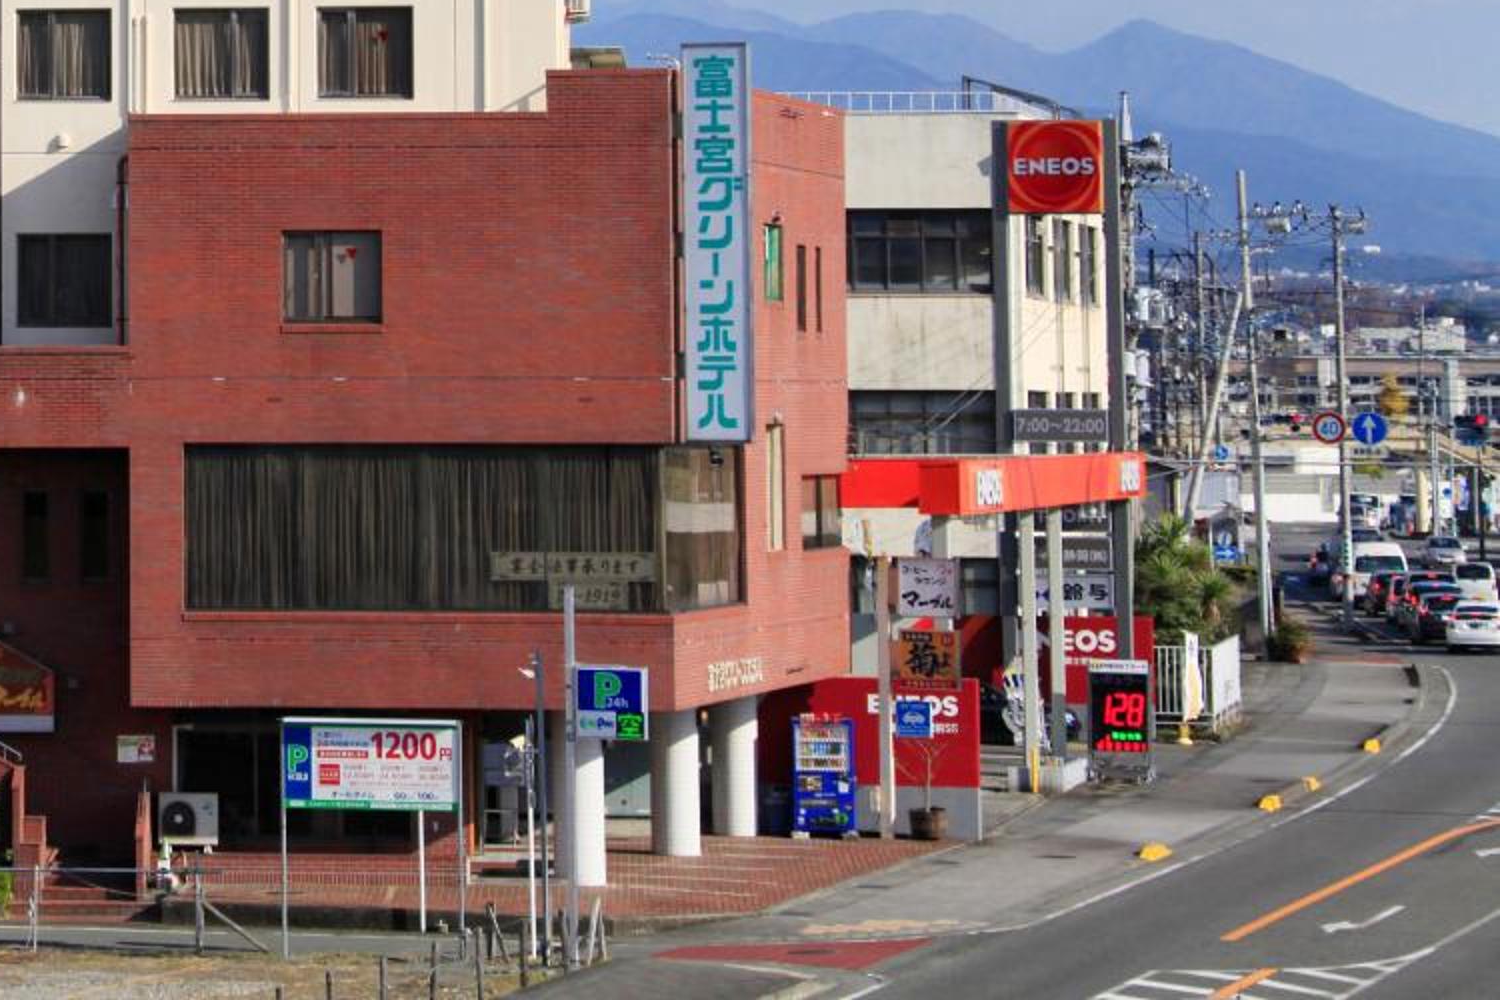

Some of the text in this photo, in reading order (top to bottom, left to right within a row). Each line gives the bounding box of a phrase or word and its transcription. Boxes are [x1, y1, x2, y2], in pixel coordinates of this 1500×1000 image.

[1013, 157, 1095, 176] ENEOS
[693, 55, 743, 429] 富士宮グリーンホテル
[1320, 422, 1338, 435] 40
[594, 671, 623, 709] P
[1103, 692, 1145, 728] 128
[617, 714, 642, 737] 空
[287, 744, 308, 772] P
